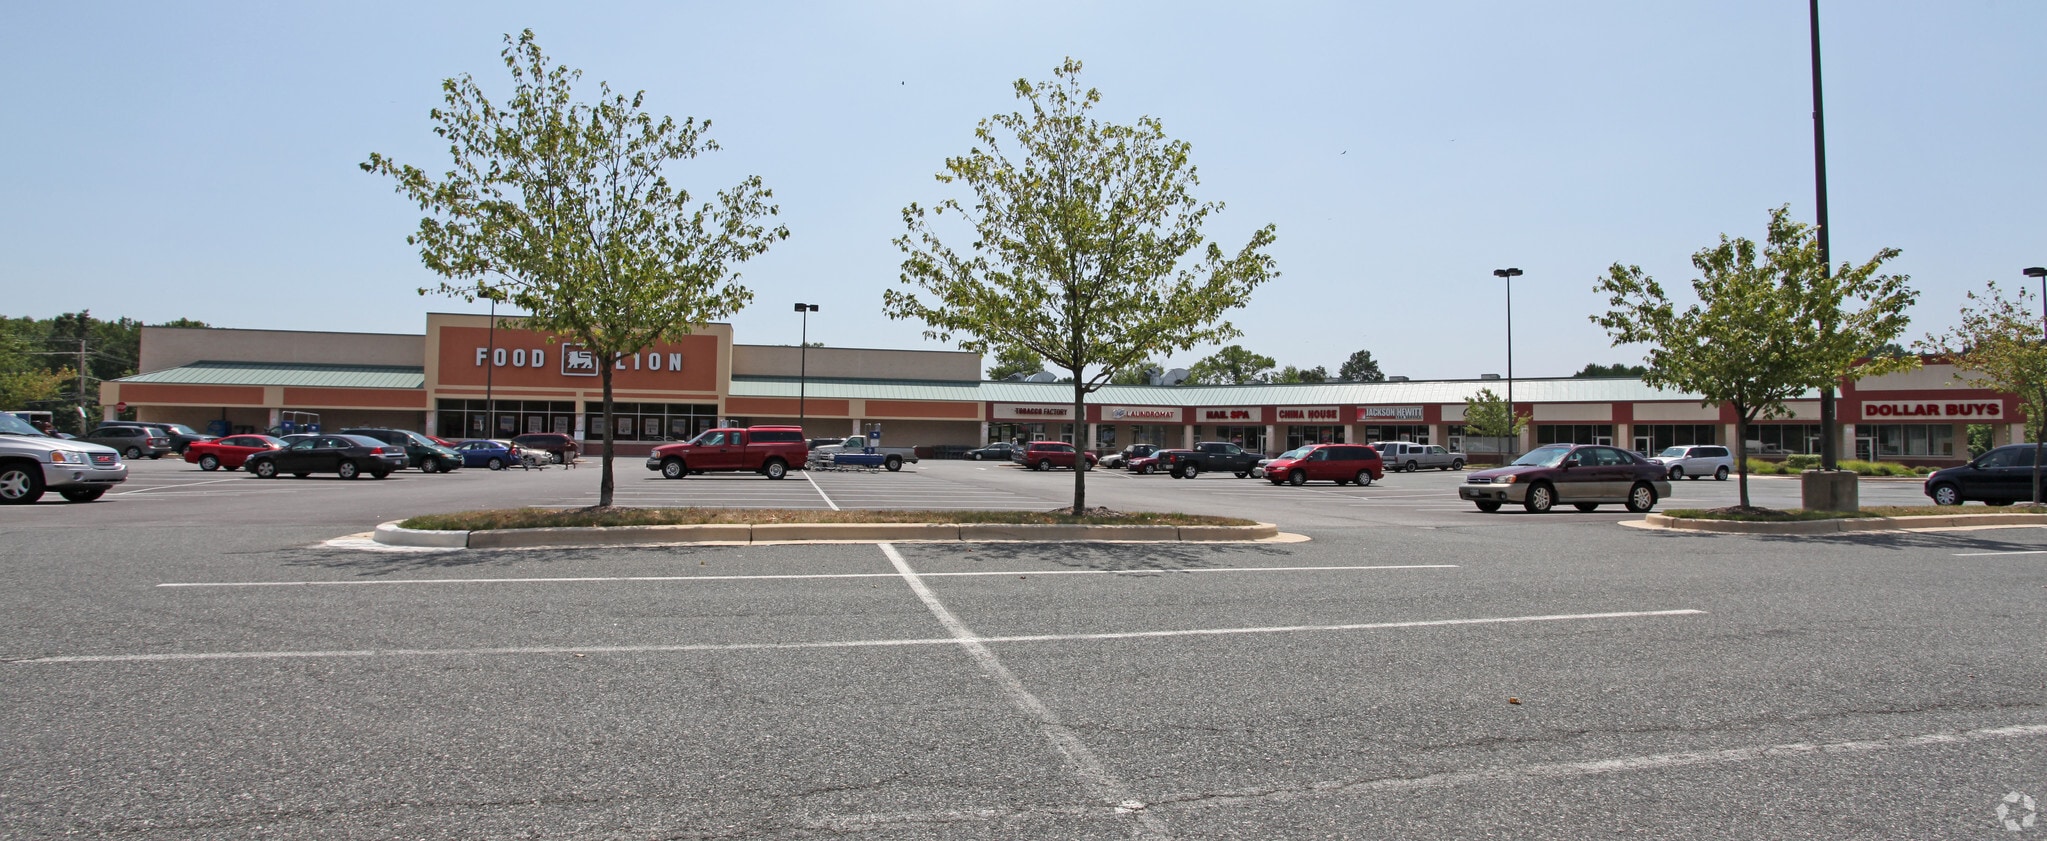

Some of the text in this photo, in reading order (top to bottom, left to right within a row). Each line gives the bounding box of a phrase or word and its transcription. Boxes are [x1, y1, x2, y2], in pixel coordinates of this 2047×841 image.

[475, 347, 682, 372] FOOD LION
[1015, 407, 1068, 416] TOBACCO FACTORY
[1126, 410, 1175, 419] LAUNDROMAT
[1206, 410, 1250, 419] NAIL SPA
[1279, 409, 1337, 419] CHINA HOUSE
[1366, 407, 1423, 417] JACKSON HEWITT
[1865, 403, 2000, 417] DOLLAR BUYS
